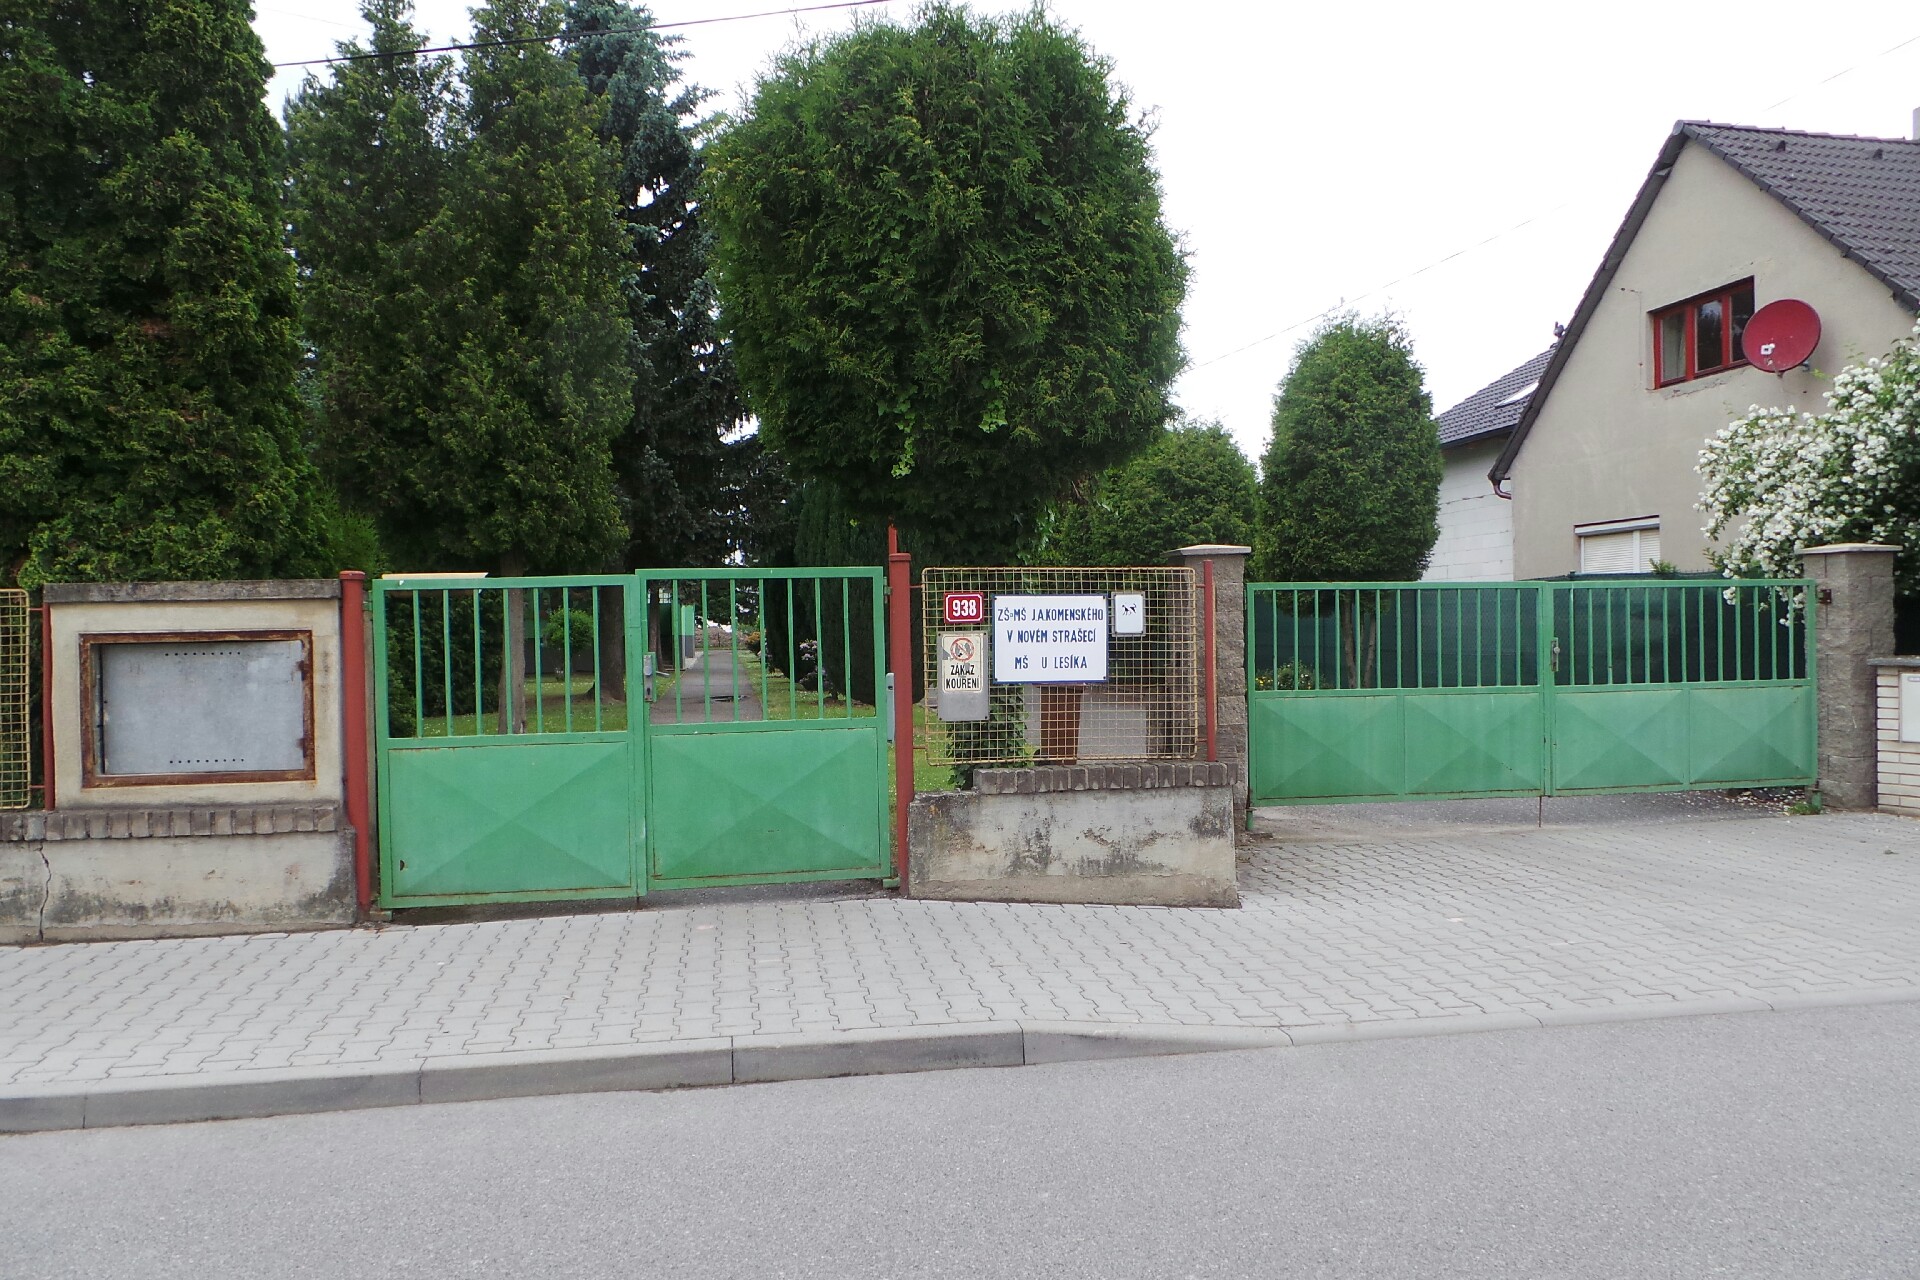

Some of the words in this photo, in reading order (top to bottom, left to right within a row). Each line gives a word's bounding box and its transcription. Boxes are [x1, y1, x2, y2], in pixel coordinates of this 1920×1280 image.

[952, 599, 977, 617] 938
[1006, 629, 1013, 643] V
[1017, 627, 1048, 643] NOVÉM
[1052, 627, 1097, 643] STRAŠECÍ
[950, 662, 975, 676] ZÁKAZ
[1014, 654, 1029, 670] MŠ
[1041, 656, 1048, 669] U
[1054, 654, 1088, 669] LESÍKA
